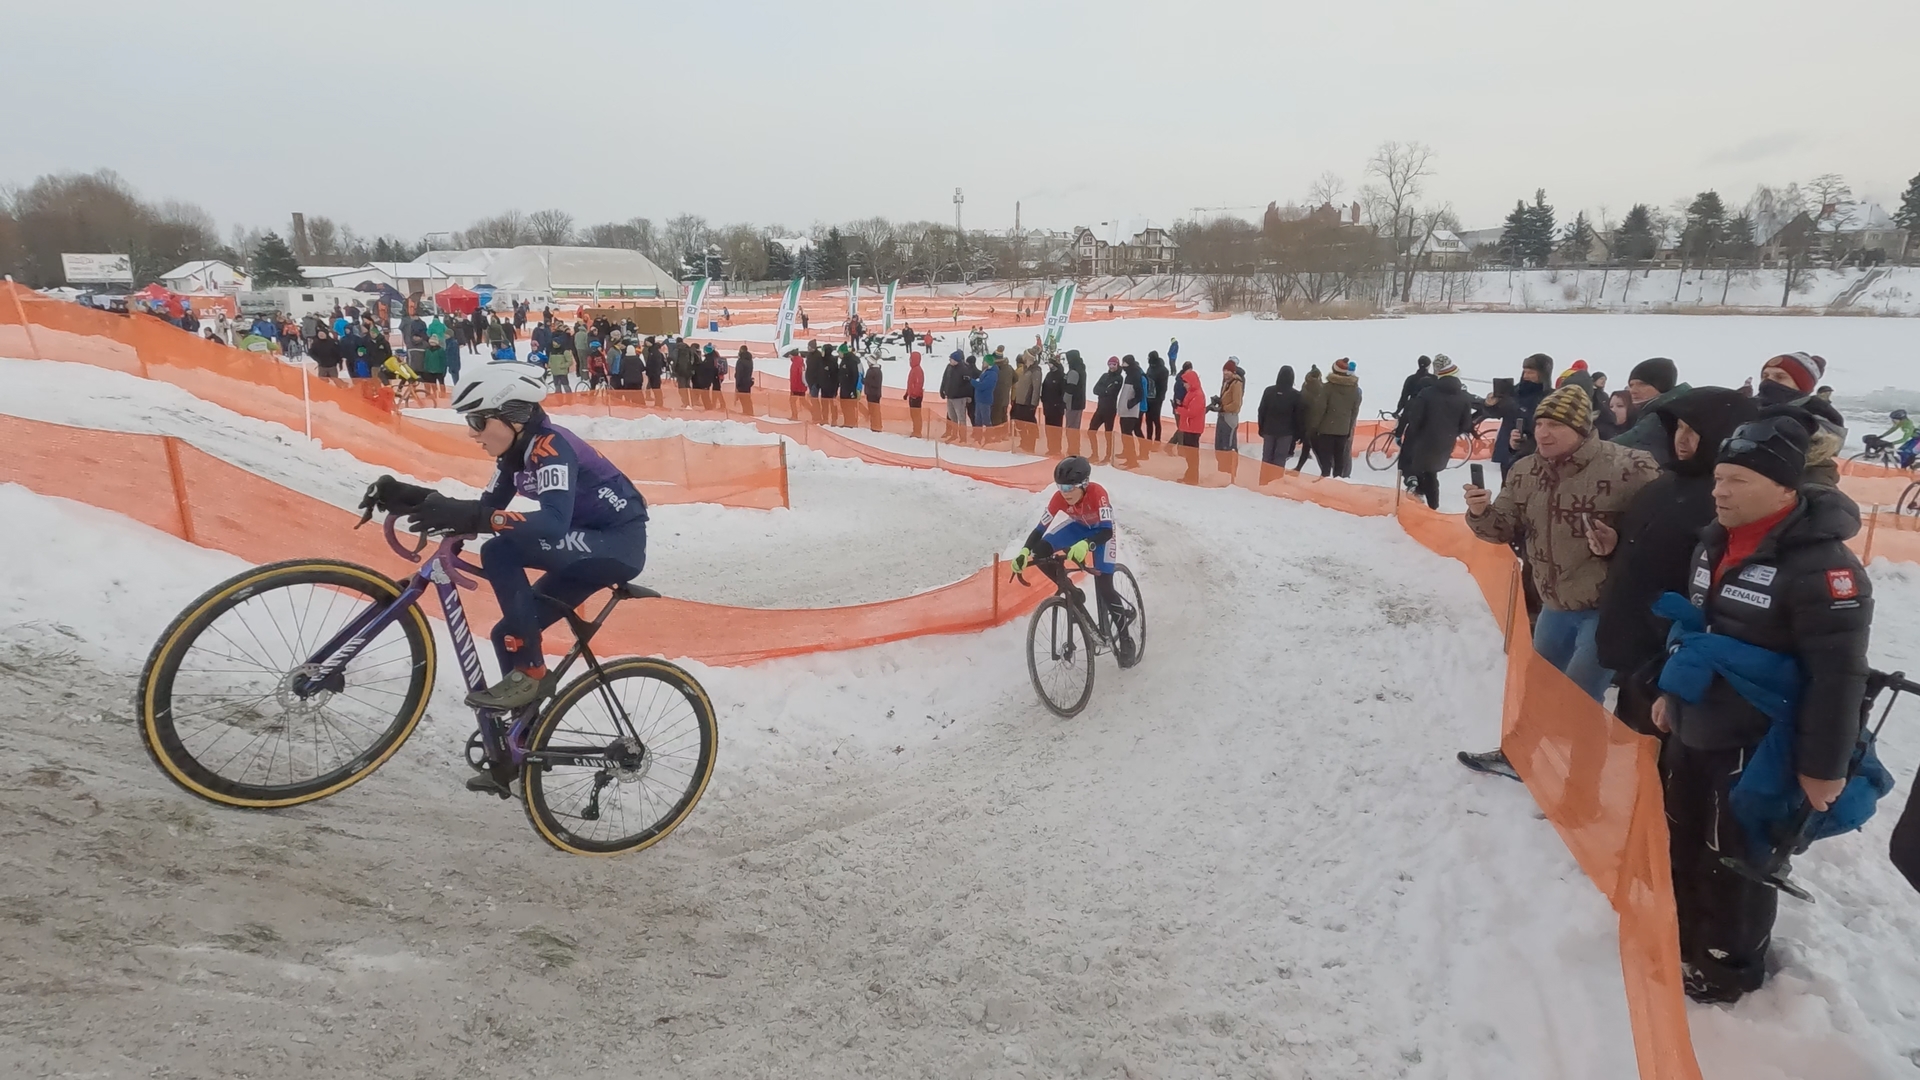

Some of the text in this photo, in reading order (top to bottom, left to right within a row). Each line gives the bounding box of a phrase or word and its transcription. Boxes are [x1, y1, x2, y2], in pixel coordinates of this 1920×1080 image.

[539, 467, 559, 490] 206
[598, 487, 628, 512] quest
[1724, 587, 1769, 605] RENAULT
[445, 589, 483, 689] CANYON
[310, 638, 366, 682] CANYON
[574, 757, 621, 769] CANYON
